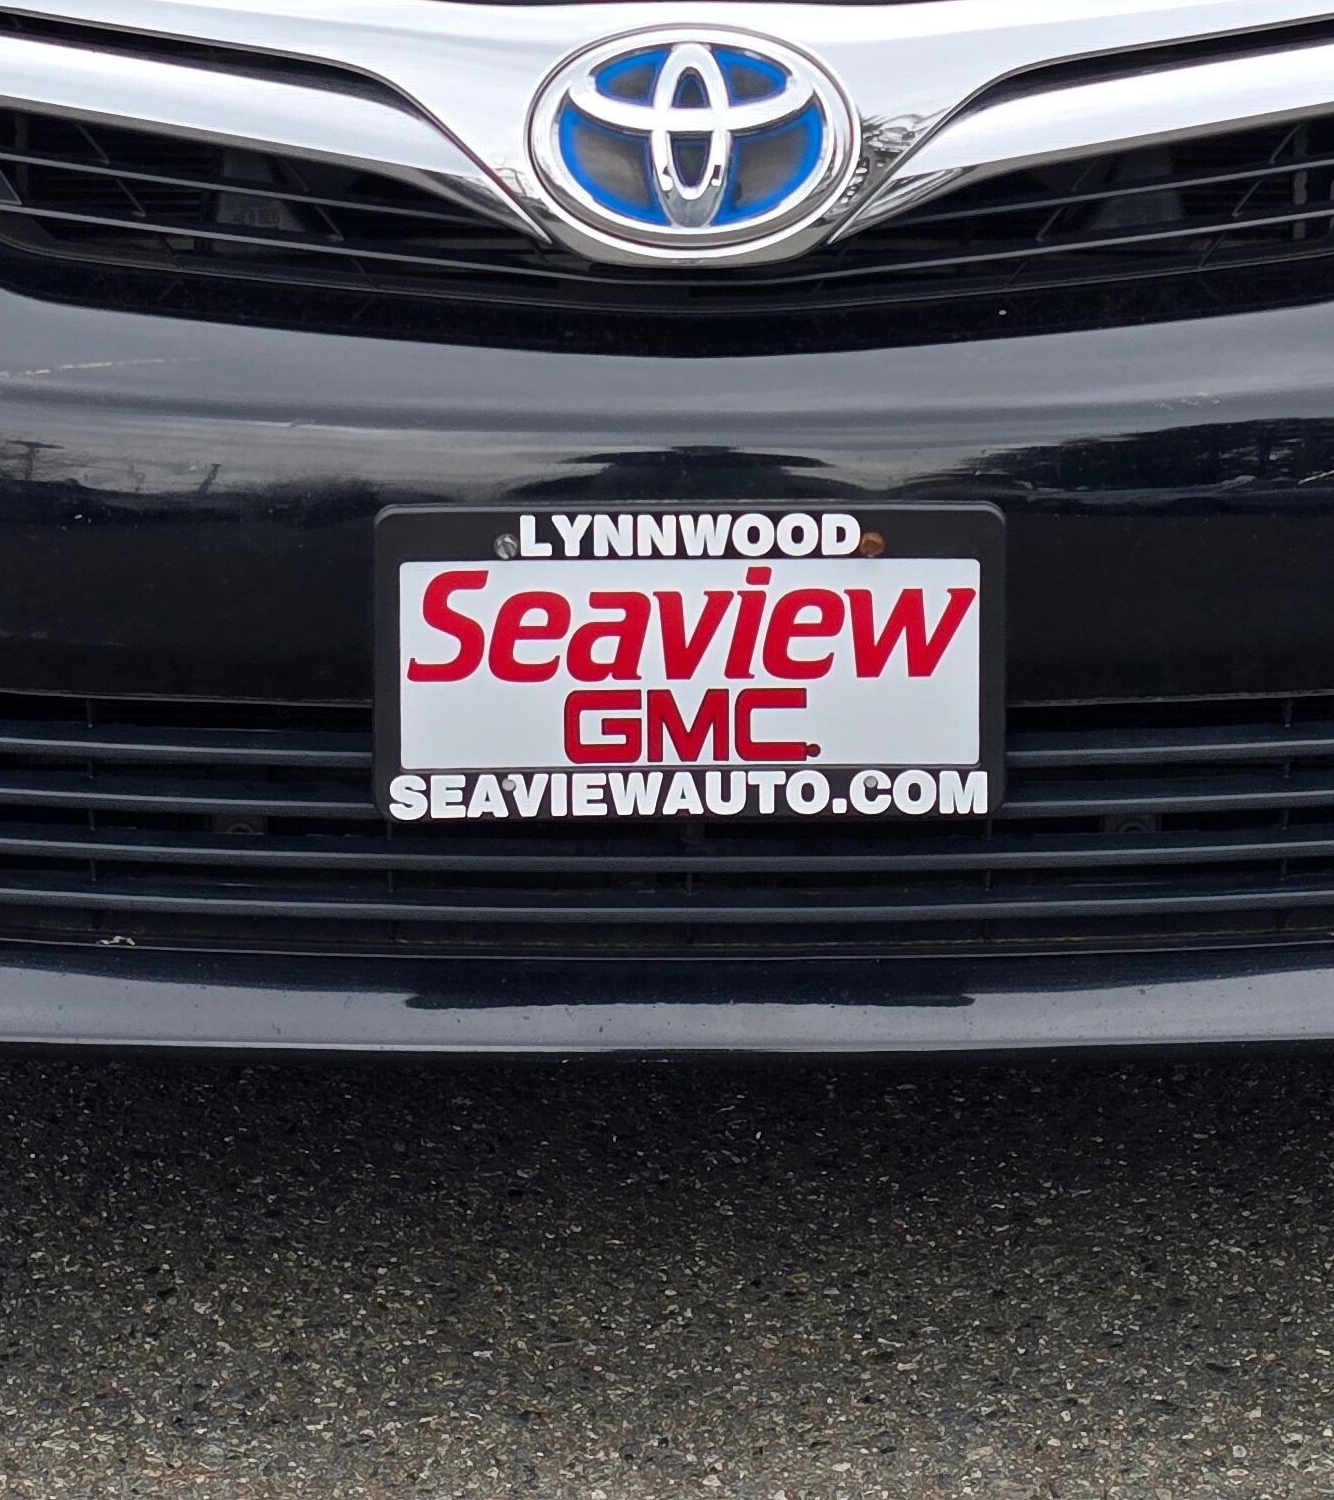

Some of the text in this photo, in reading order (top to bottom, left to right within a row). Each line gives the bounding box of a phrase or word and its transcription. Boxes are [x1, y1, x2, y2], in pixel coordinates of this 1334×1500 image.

[518, 512, 863, 559] LYNNWOOD
[406, 565, 976, 684] Seaview
[563, 686, 810, 763] GMC
[387, 769, 989, 821] SEAVIEWAUTO.COM
